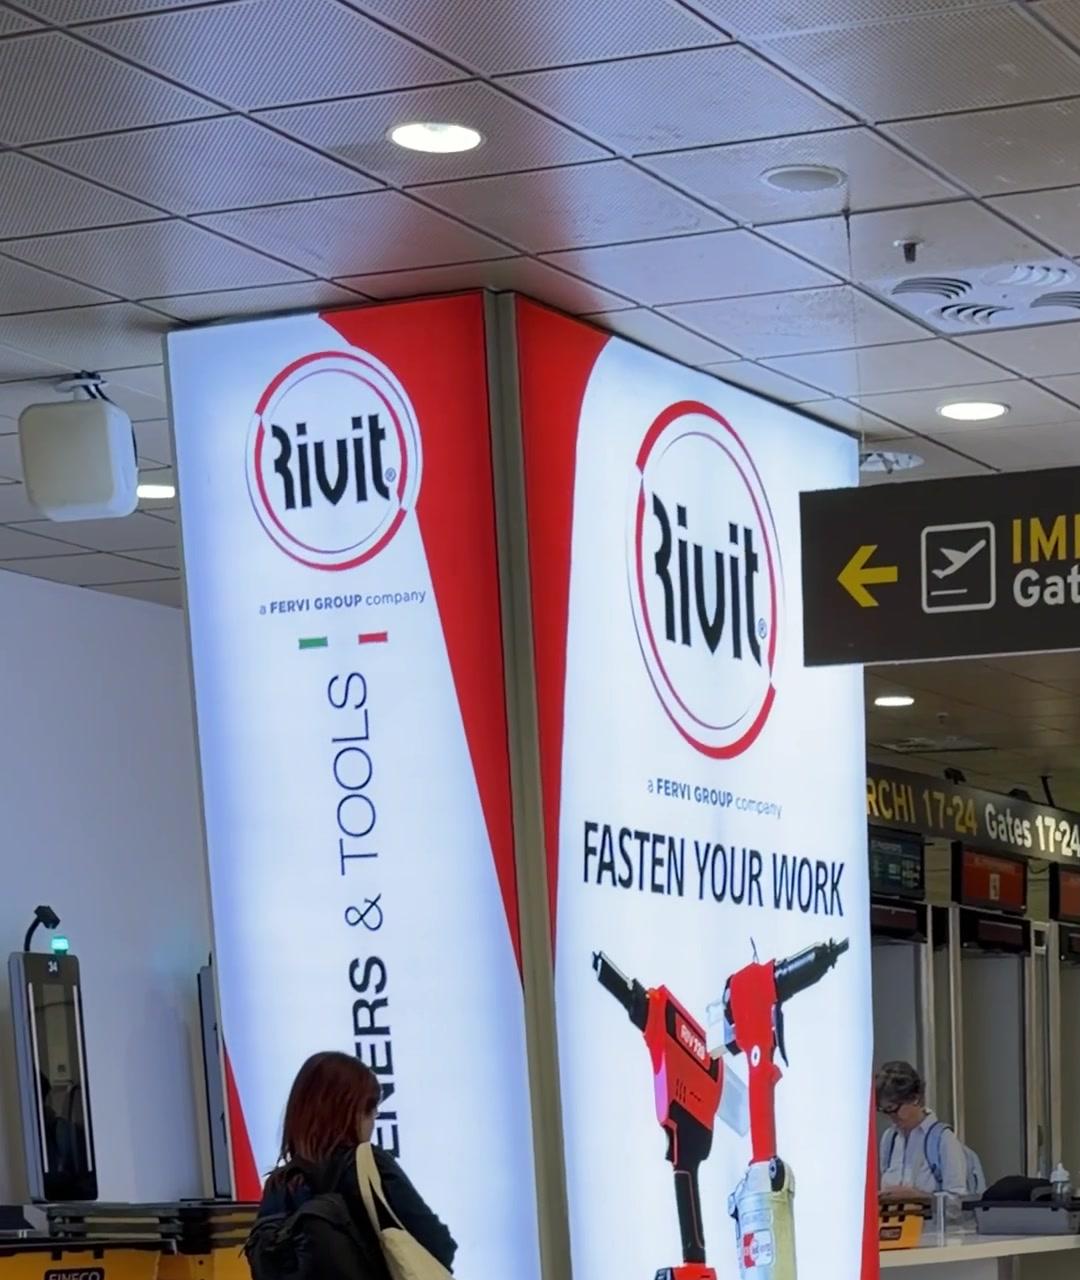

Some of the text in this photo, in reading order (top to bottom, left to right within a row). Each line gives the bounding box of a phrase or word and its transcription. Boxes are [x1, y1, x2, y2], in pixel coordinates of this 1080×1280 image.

[270, 413, 390, 510] Rivit
[258, 590, 427, 615] a FERVI GROUP company
[652, 491, 762, 668] Rivit
[327, 672, 379, 876] TOOLS
[647, 778, 782, 820] a FERVI GROUP company
[922, 788, 978, 837] 17-24
[984, 802, 1033, 849] Gates
[583, 820, 845, 917] FASTEN YOUR WORK
[344, 893, 383, 931] &
